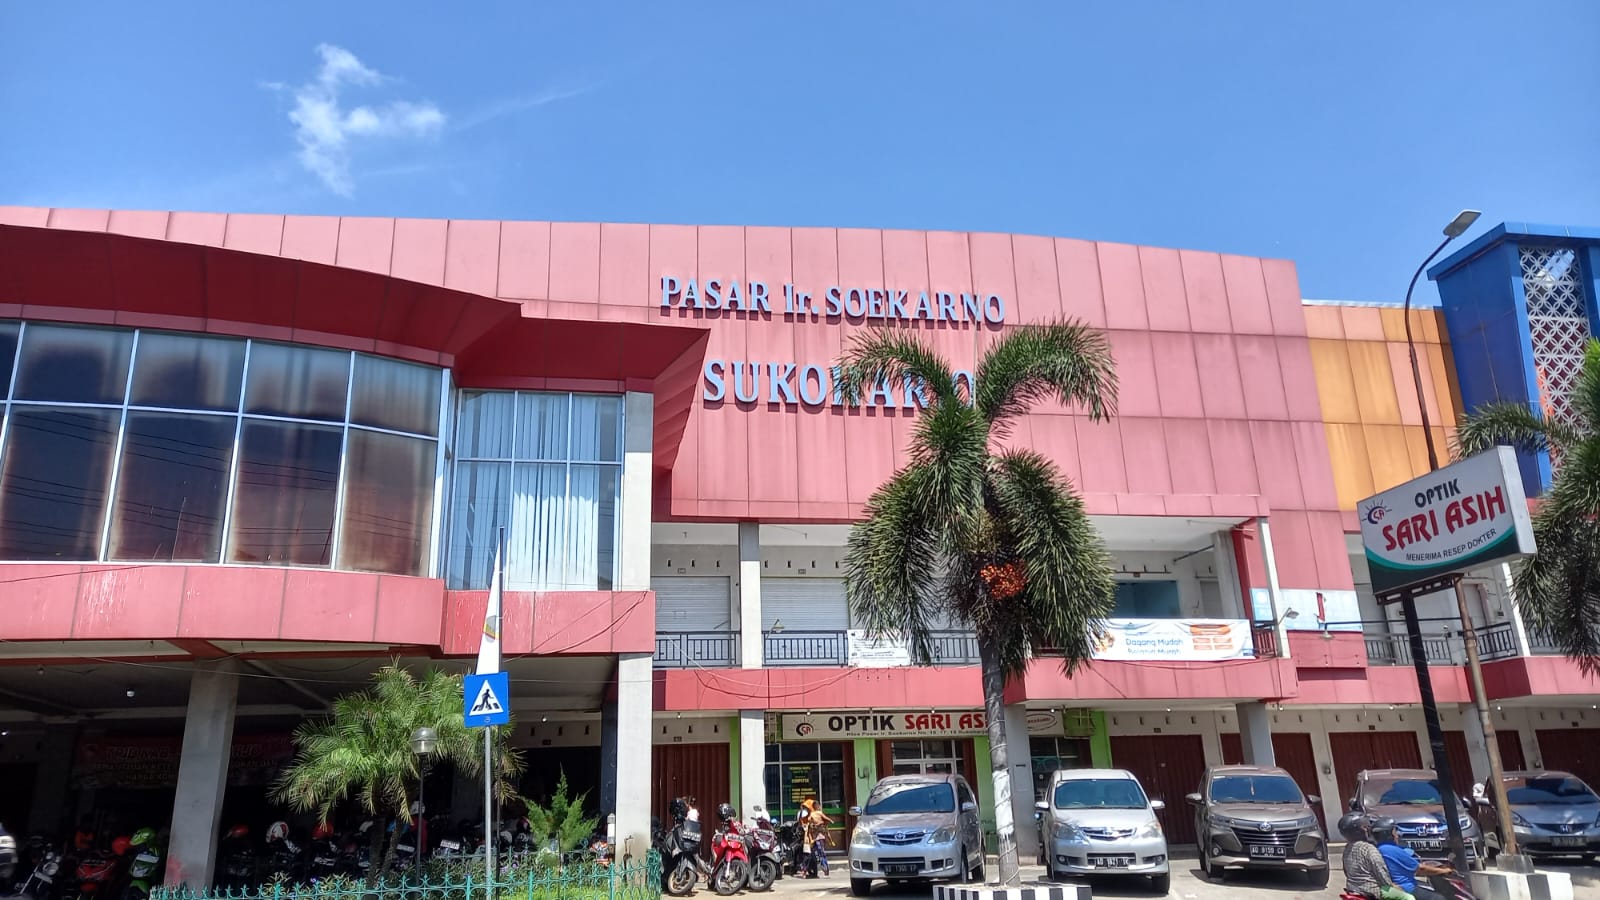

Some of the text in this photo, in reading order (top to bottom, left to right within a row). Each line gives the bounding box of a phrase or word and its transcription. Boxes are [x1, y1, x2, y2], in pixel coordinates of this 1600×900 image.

[661, 276, 1005, 323] PASAR Ir. SOEKARNO
[703, 358, 977, 409] SUKOHARO
[1414, 478, 1461, 508] OPTIK
[1382, 485, 1506, 552] SARI ASIH
[1406, 528, 1497, 561] MENERIMA RESEP DOKTER
[1125, 638, 1184, 647] Dagang Mudah
[828, 715, 895, 731] OPTIK
[904, 714, 951, 730] SARI
